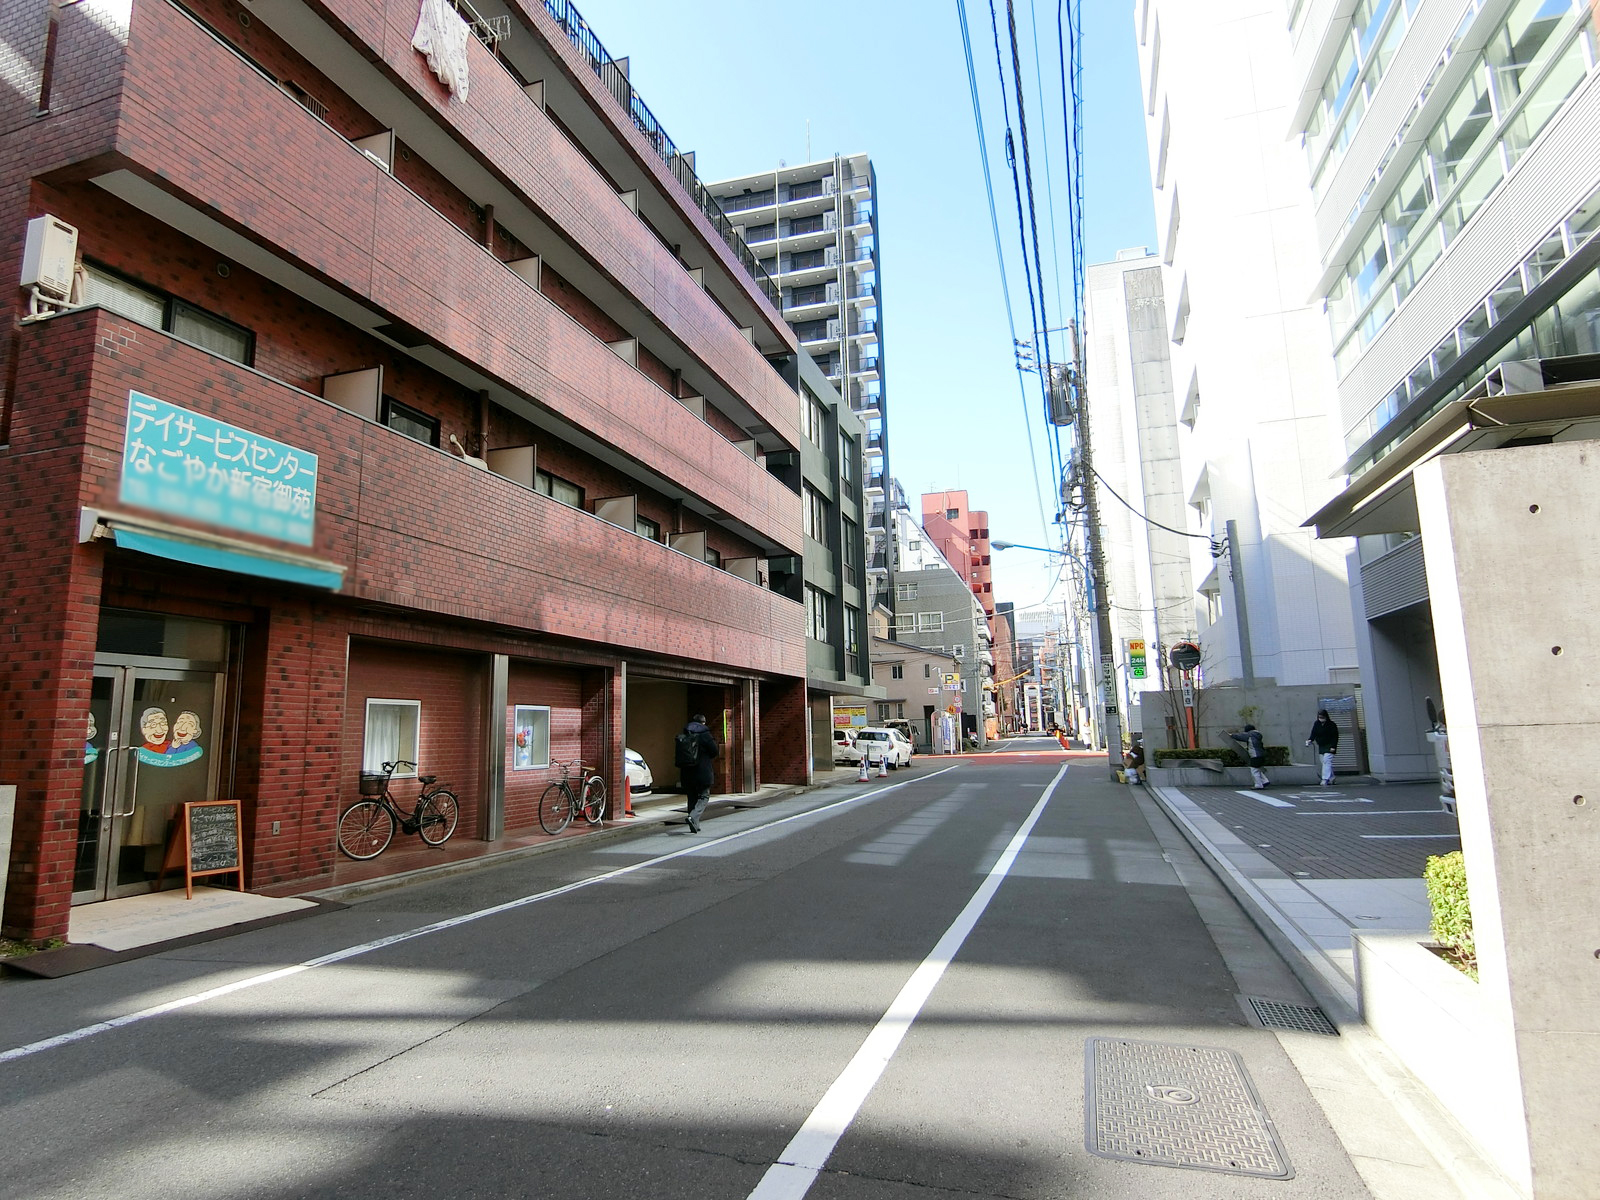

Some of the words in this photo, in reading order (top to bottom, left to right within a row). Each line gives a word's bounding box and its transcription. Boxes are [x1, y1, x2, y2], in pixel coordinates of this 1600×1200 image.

[132, 400, 315, 480] デイサービスセンター
